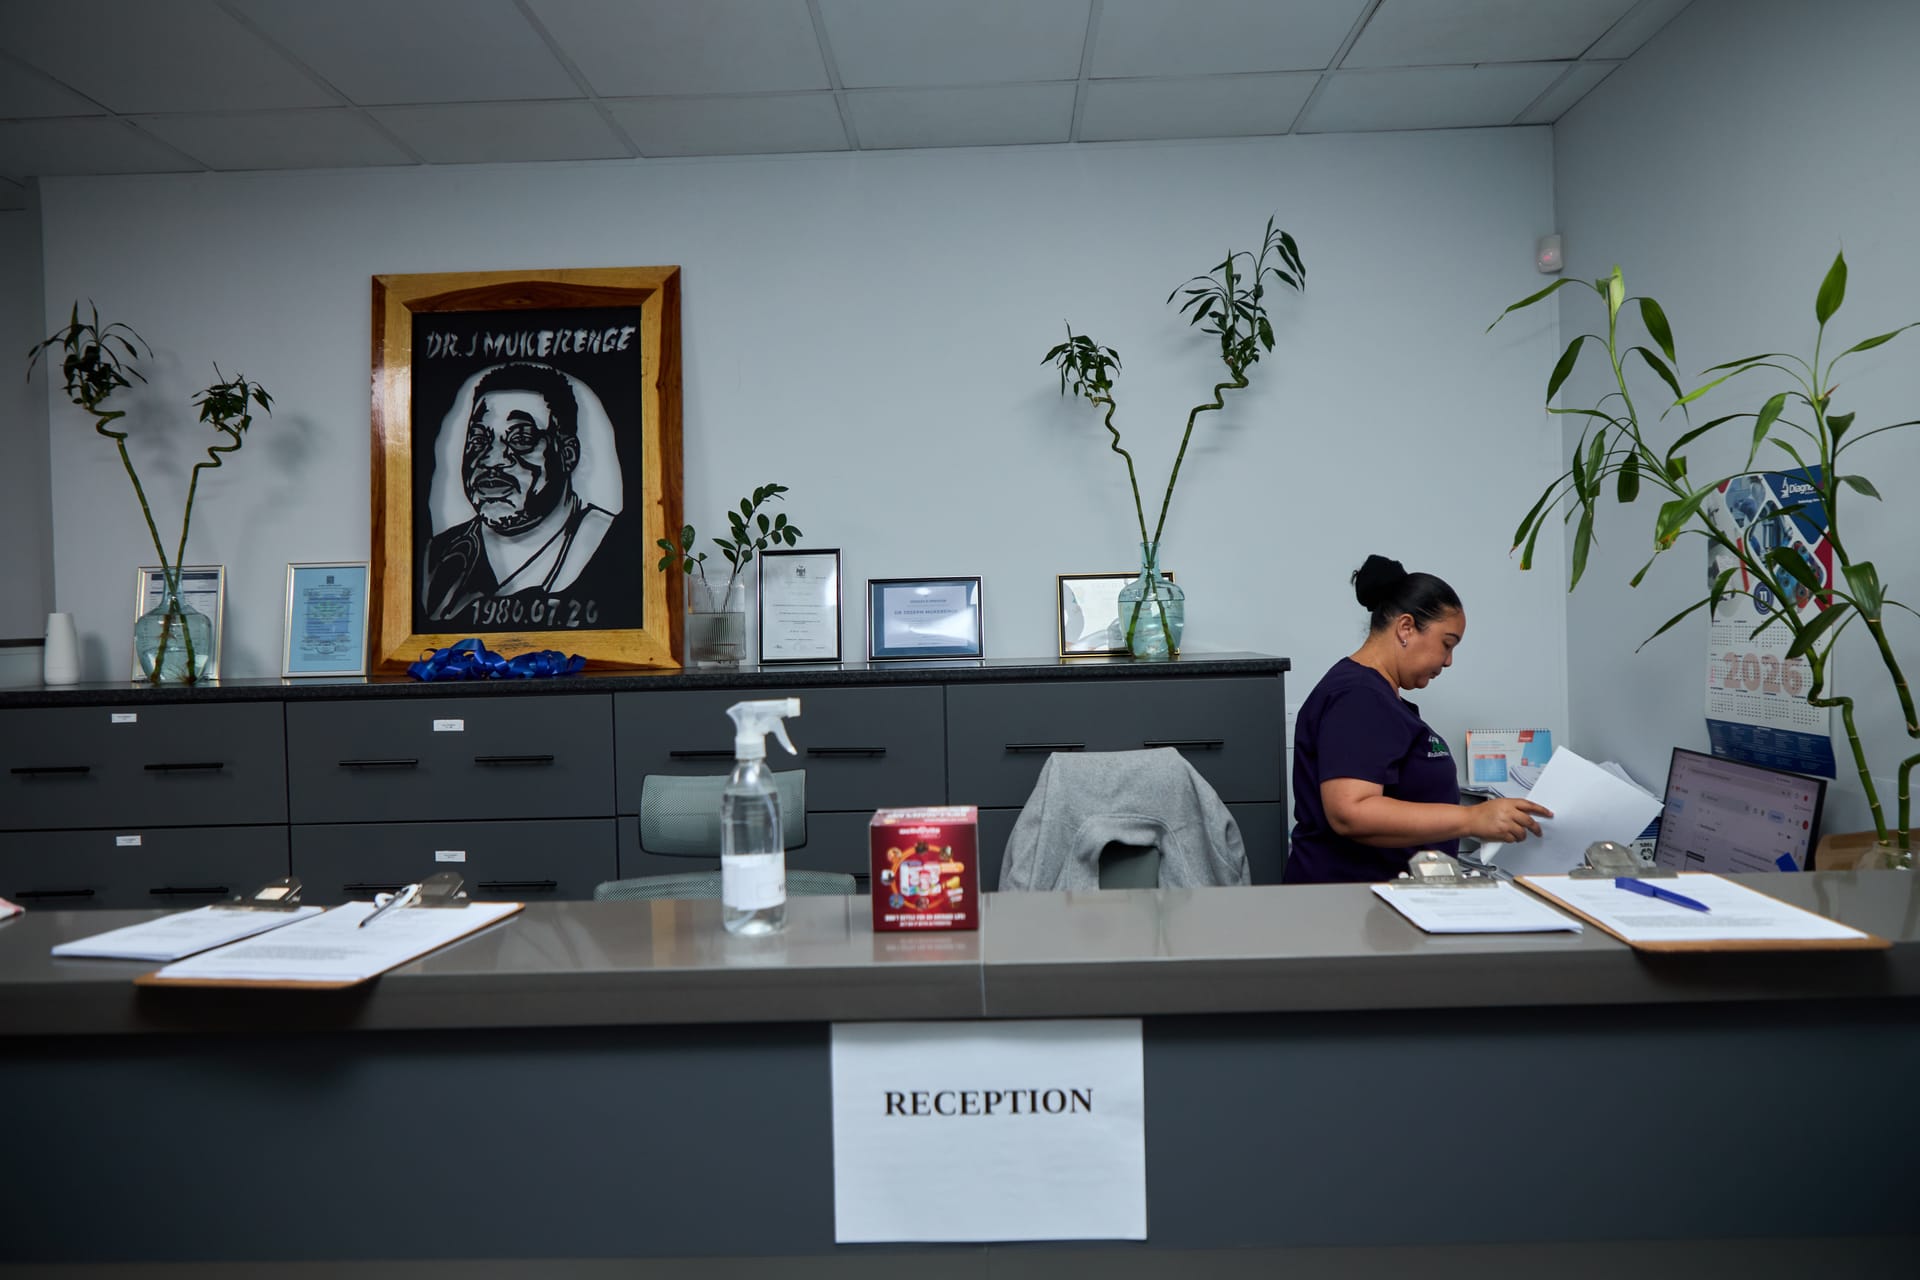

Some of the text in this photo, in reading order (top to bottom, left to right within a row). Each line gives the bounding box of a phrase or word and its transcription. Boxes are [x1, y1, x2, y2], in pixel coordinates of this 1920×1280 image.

[426, 325, 637, 359] DR. J MUKERENGE
[1723, 651, 1803, 696] 2026
[884, 1087, 1093, 1117] RECEPTION
